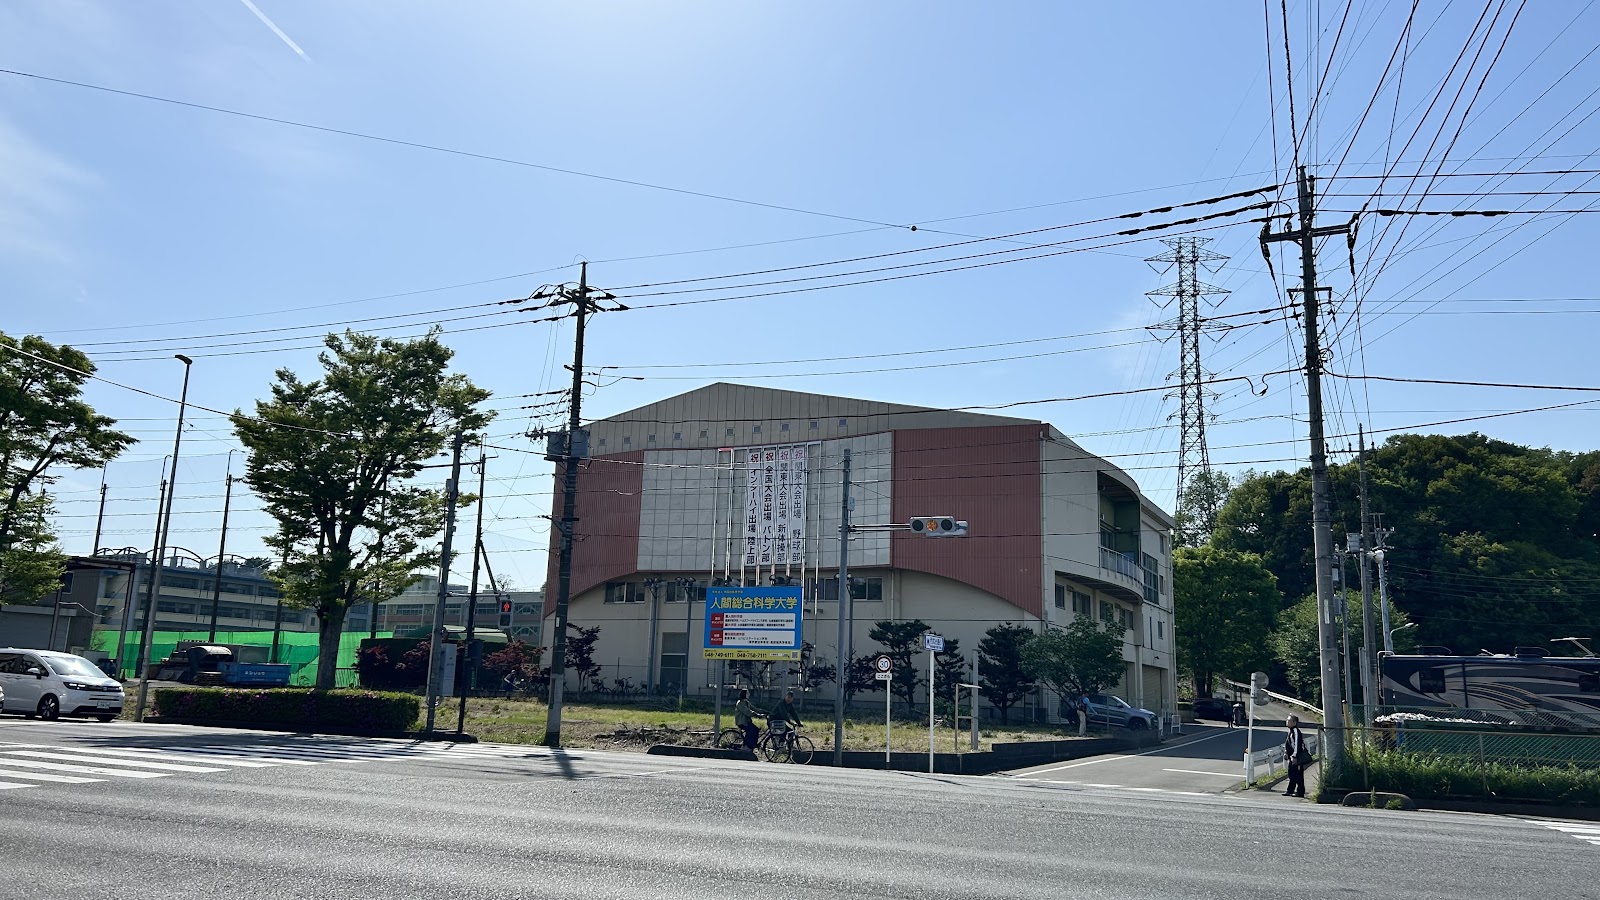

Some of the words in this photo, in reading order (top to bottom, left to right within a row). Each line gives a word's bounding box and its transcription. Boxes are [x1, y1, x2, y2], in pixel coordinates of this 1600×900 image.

[750, 453, 759, 462] 祝
[765, 452, 774, 461] 祝
[780, 450, 789, 460] 祝
[794, 449, 803, 459] 祝
[748, 469, 758, 533] インターハイ出場
[763, 465, 774, 522] 全国大会出場
[778, 462, 788, 519] 関東大会出場
[793, 462, 803, 519] 関東大会出場
[761, 525, 771, 562] バトン部
[776, 524, 787, 562] 新体操部
[792, 529, 801, 562] 野球部
[710, 596, 798, 610] 人間総合科学大学
